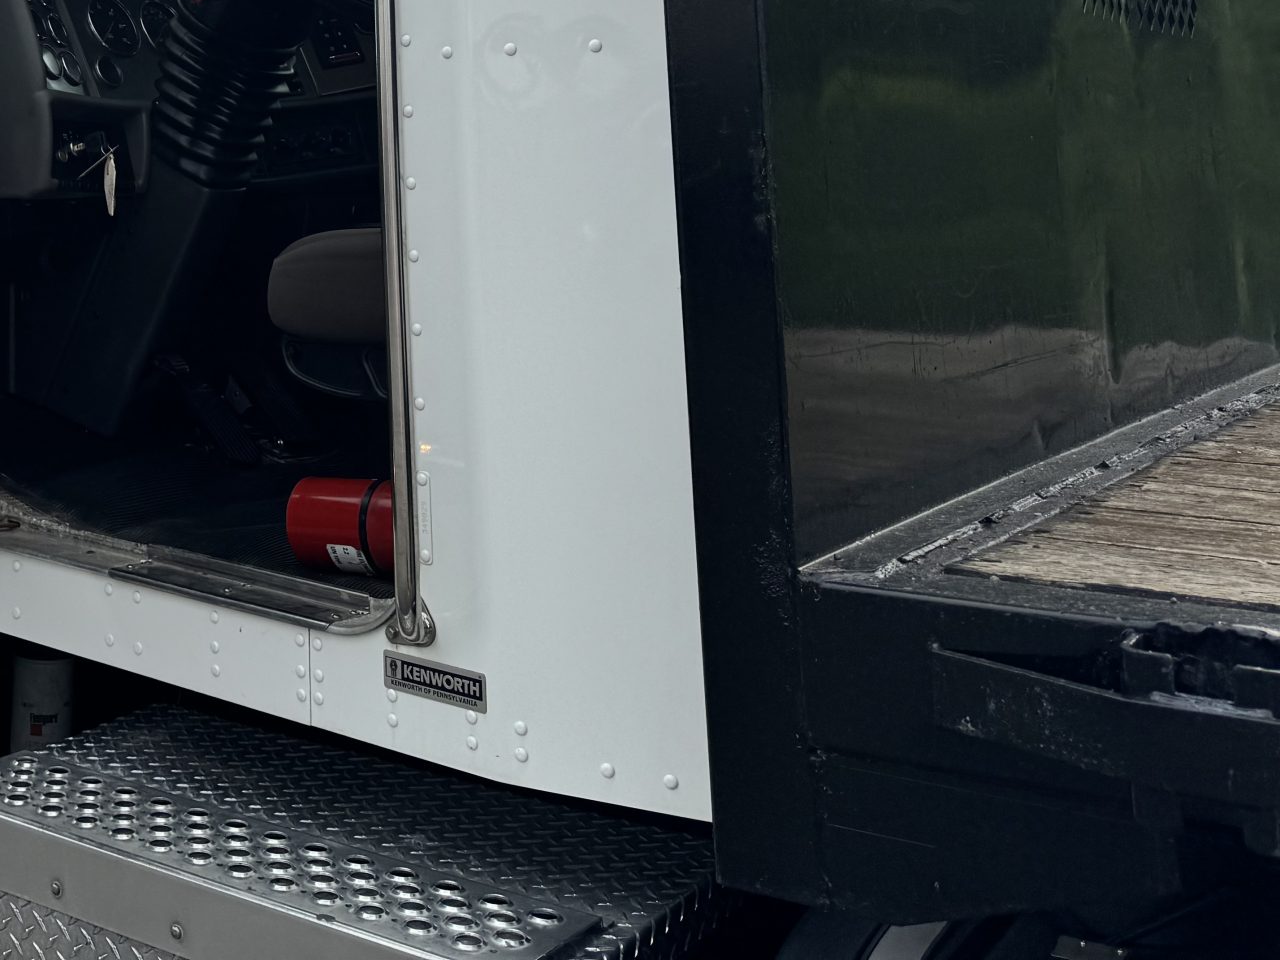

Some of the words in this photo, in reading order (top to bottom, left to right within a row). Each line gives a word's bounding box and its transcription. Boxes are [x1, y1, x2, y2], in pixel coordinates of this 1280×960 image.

[390, 679, 423, 693] KENWORTH
[432, 690, 478, 707] PENNSYLVANIA
[403, 664, 480, 697] KENWORTH
